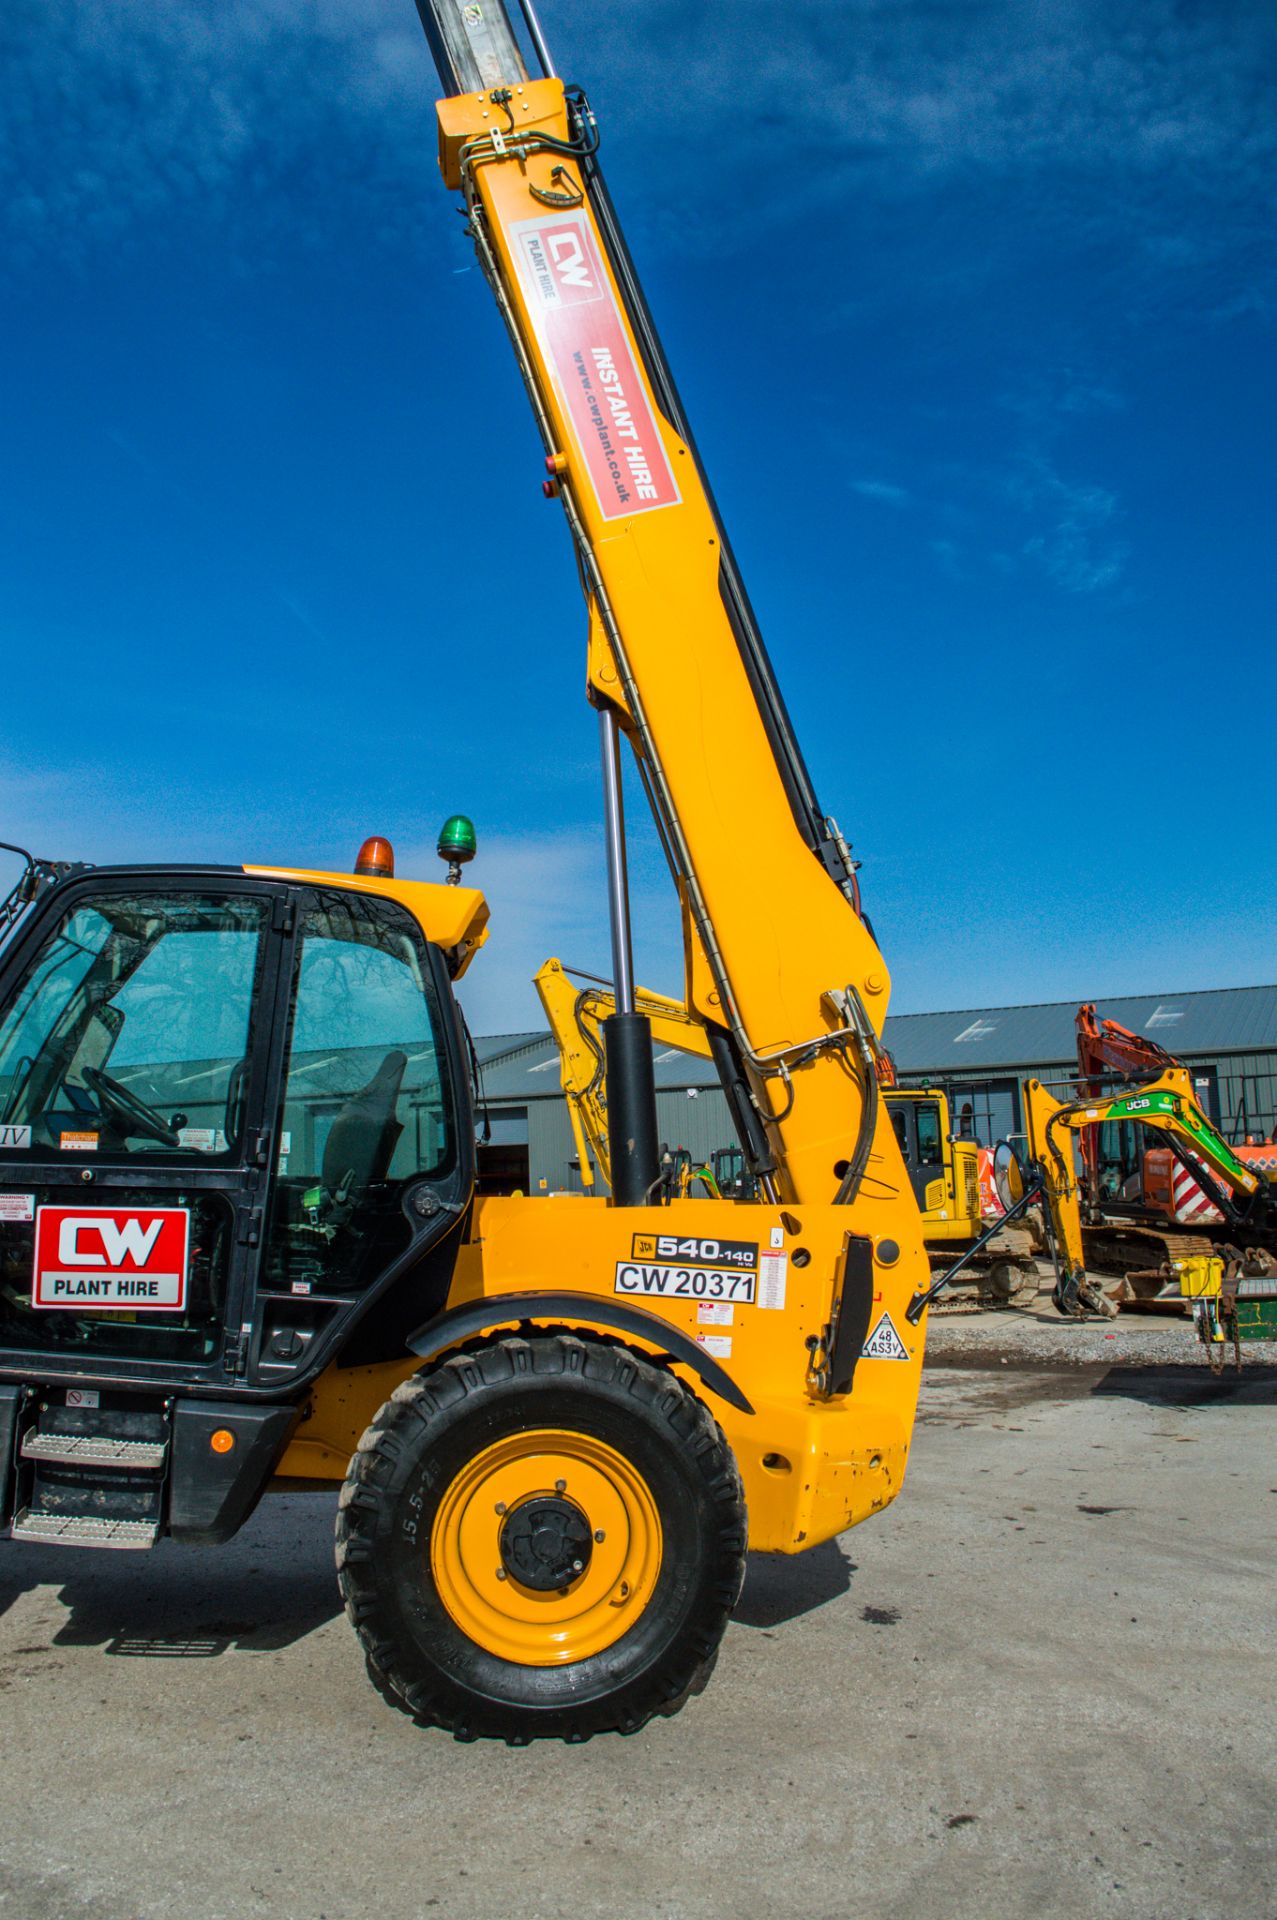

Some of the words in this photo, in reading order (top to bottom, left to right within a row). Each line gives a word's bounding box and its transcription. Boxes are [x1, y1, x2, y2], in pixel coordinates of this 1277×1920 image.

[528, 239, 548, 272] PLANT
[539, 274, 556, 299] HIRE
[547, 232, 593, 288] CW
[572, 351, 631, 503] www.cwplant.co.uk
[591, 347, 639, 441] INSTANT
[623, 446, 658, 500] HIRE
[1126, 1098, 1150, 1111] JCB
[58, 1217, 165, 1267] CW
[54, 1279, 112, 1295] PLANT
[117, 1280, 159, 1296] HIRE
[619, 1266, 670, 1292] CW
[674, 1270, 753, 1300] 20371
[878, 1330, 892, 1341] 48
